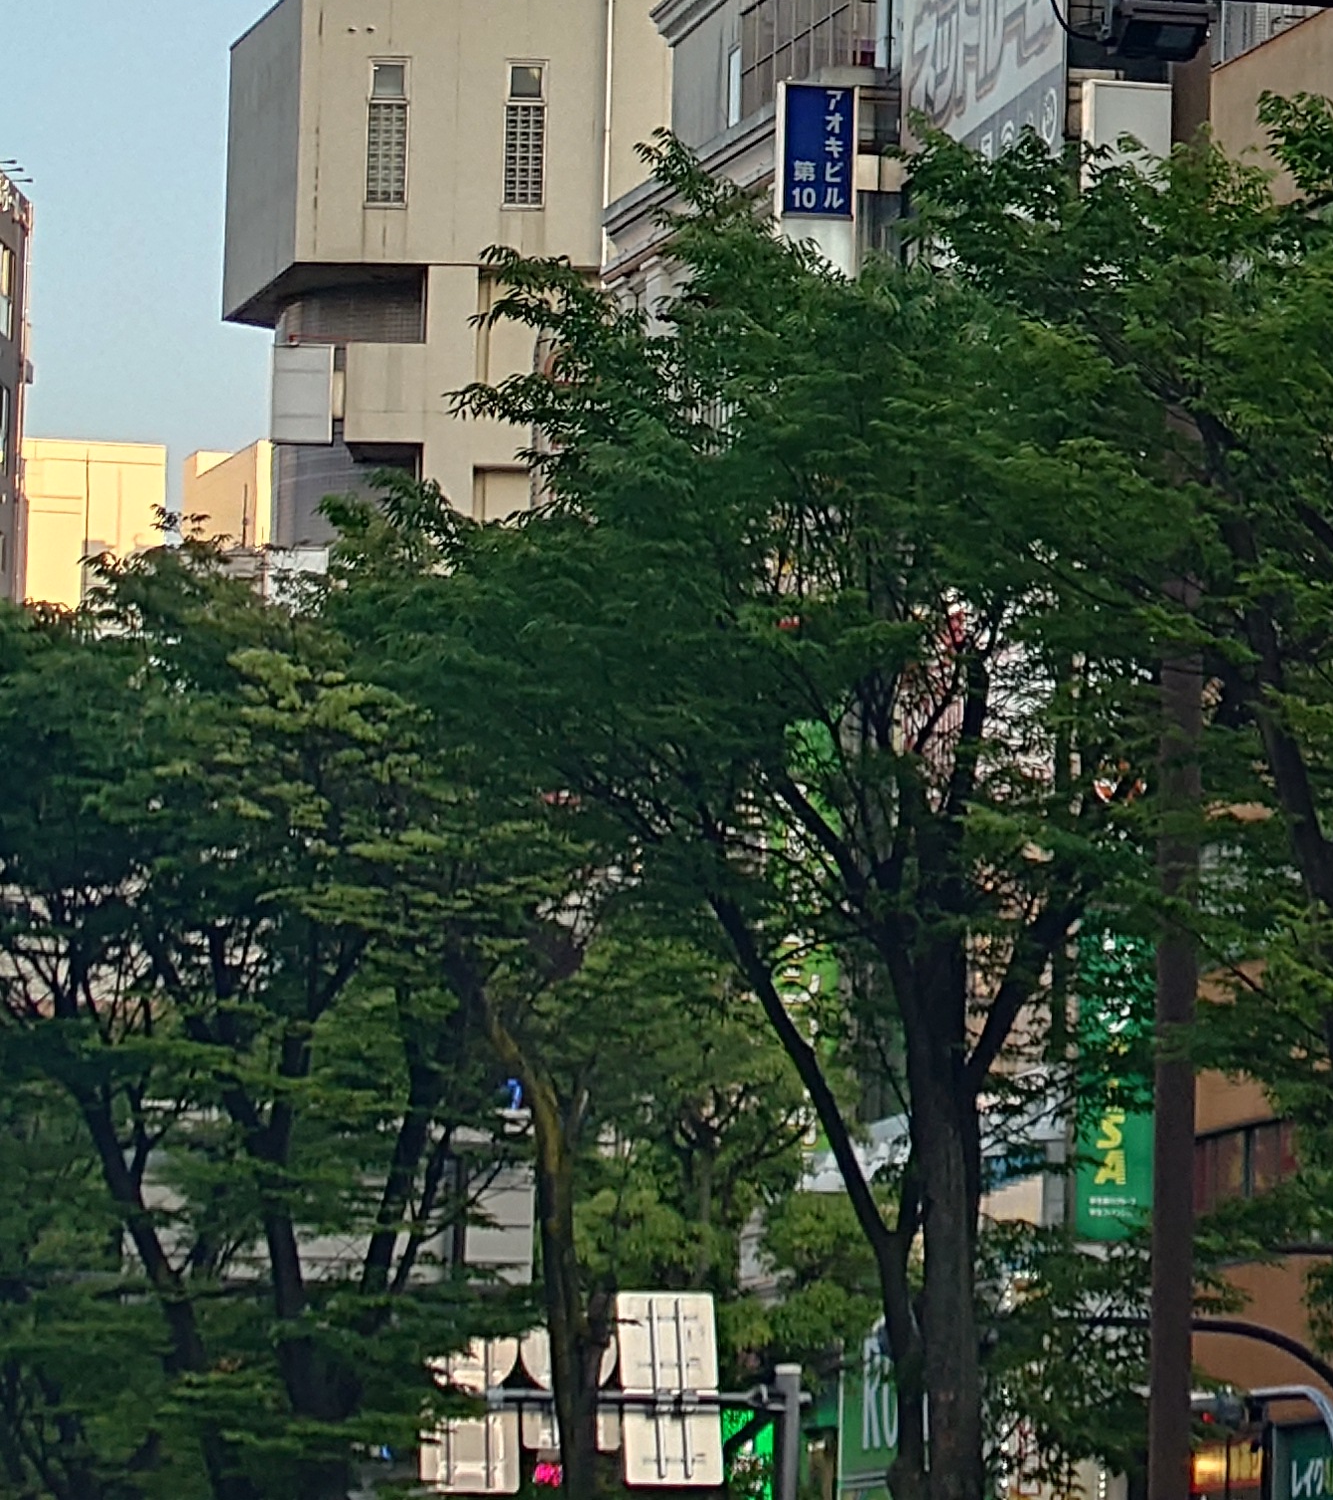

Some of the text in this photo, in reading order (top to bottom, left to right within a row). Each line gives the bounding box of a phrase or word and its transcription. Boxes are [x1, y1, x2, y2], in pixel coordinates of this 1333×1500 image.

[792, 160, 817, 209] 第10
[822, 90, 845, 210] アオキビル
